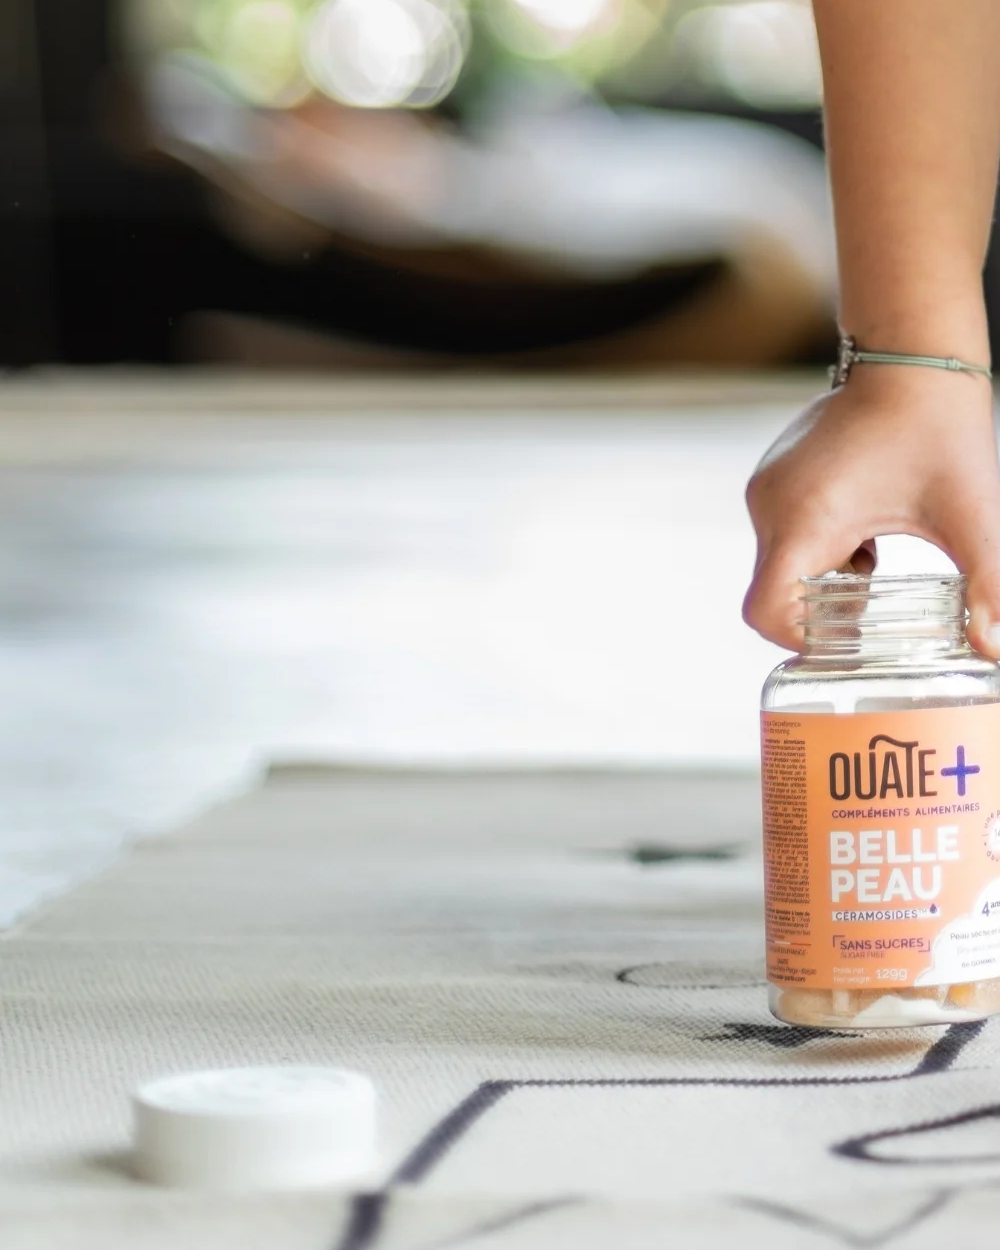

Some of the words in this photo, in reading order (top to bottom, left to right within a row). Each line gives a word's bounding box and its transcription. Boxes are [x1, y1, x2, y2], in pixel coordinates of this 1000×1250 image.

[831, 806, 910, 819] COMPLÉMENTS
[915, 802, 980, 816] ALIMENTAIRES
[829, 825, 960, 865] BELLE
[830, 865, 943, 903] PEAU
[982, 901, 990, 917] 4
[840, 940, 872, 950] SANS
[875, 937, 924, 949] SUCRES
[950, 932, 969, 940] Peau
[841, 951, 865, 959] SUGAR
[876, 967, 908, 981] 129g
